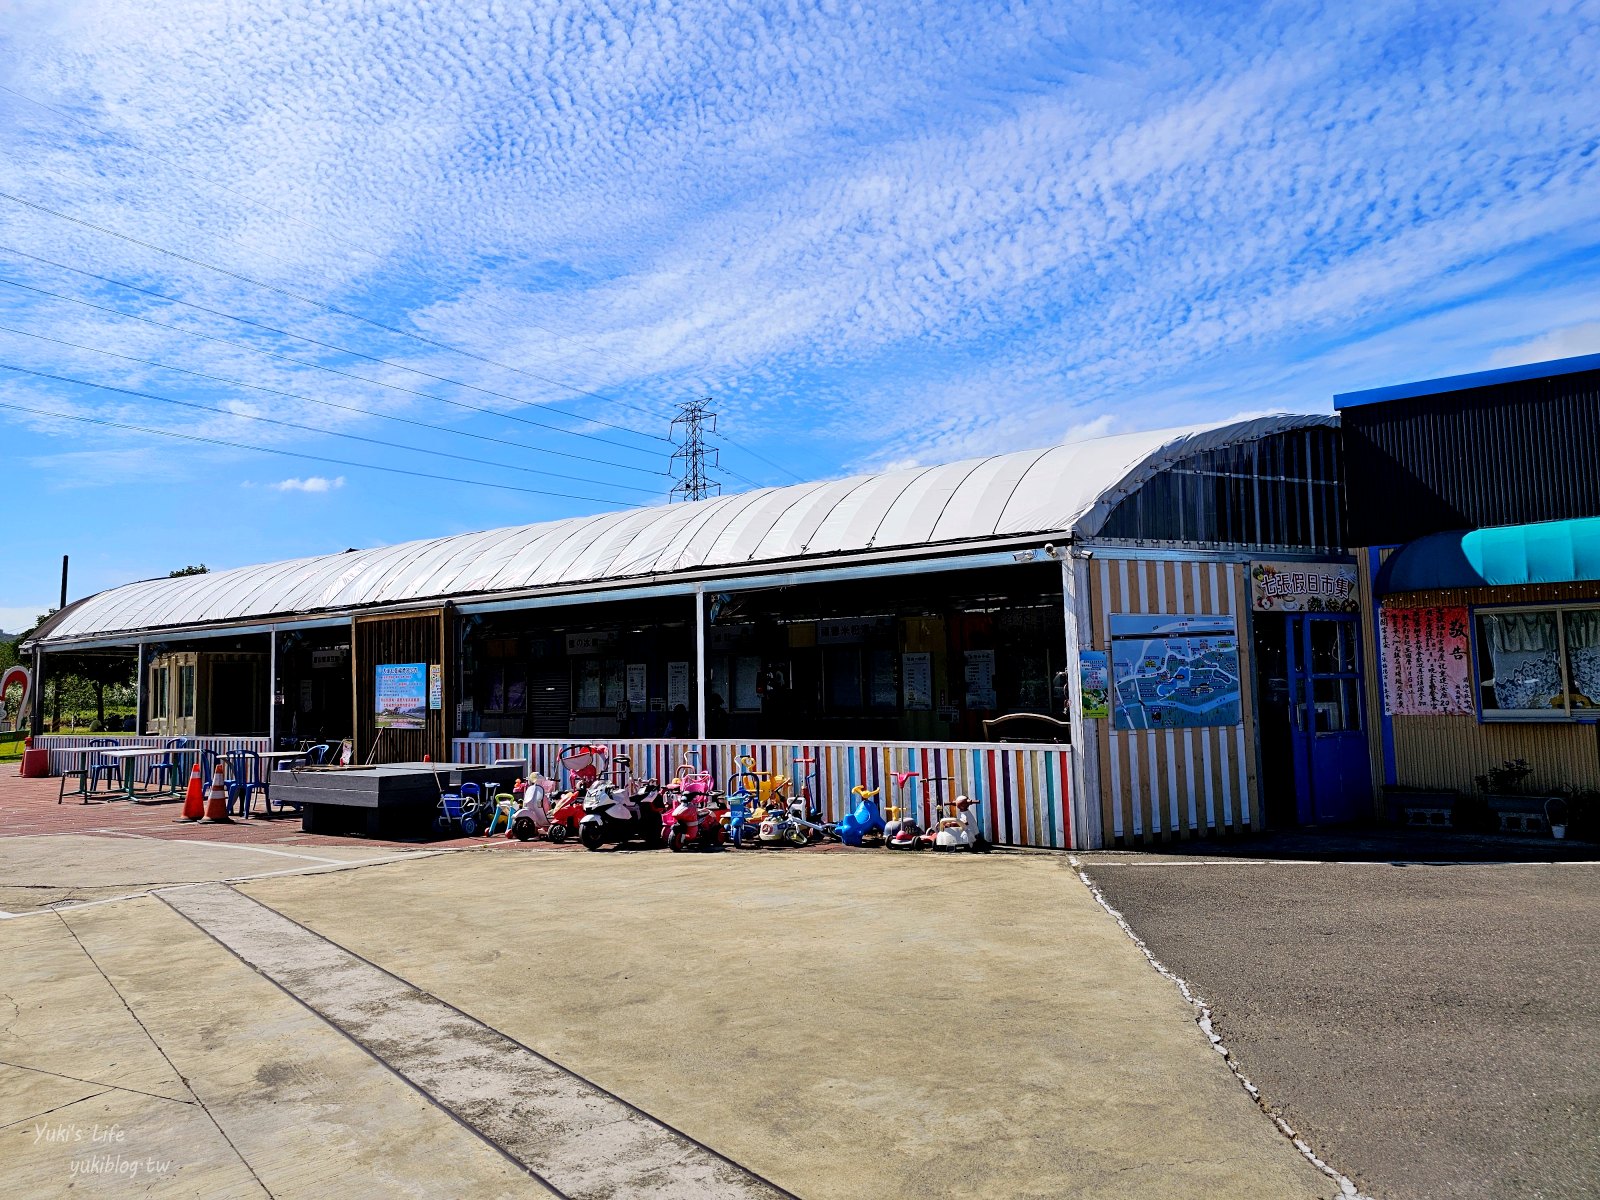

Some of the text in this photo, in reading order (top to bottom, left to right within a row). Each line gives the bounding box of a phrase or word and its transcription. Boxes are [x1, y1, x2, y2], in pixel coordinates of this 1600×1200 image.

[1261, 572, 1349, 599] 七張假日市集
[1449, 618, 1468, 661] 敬告
